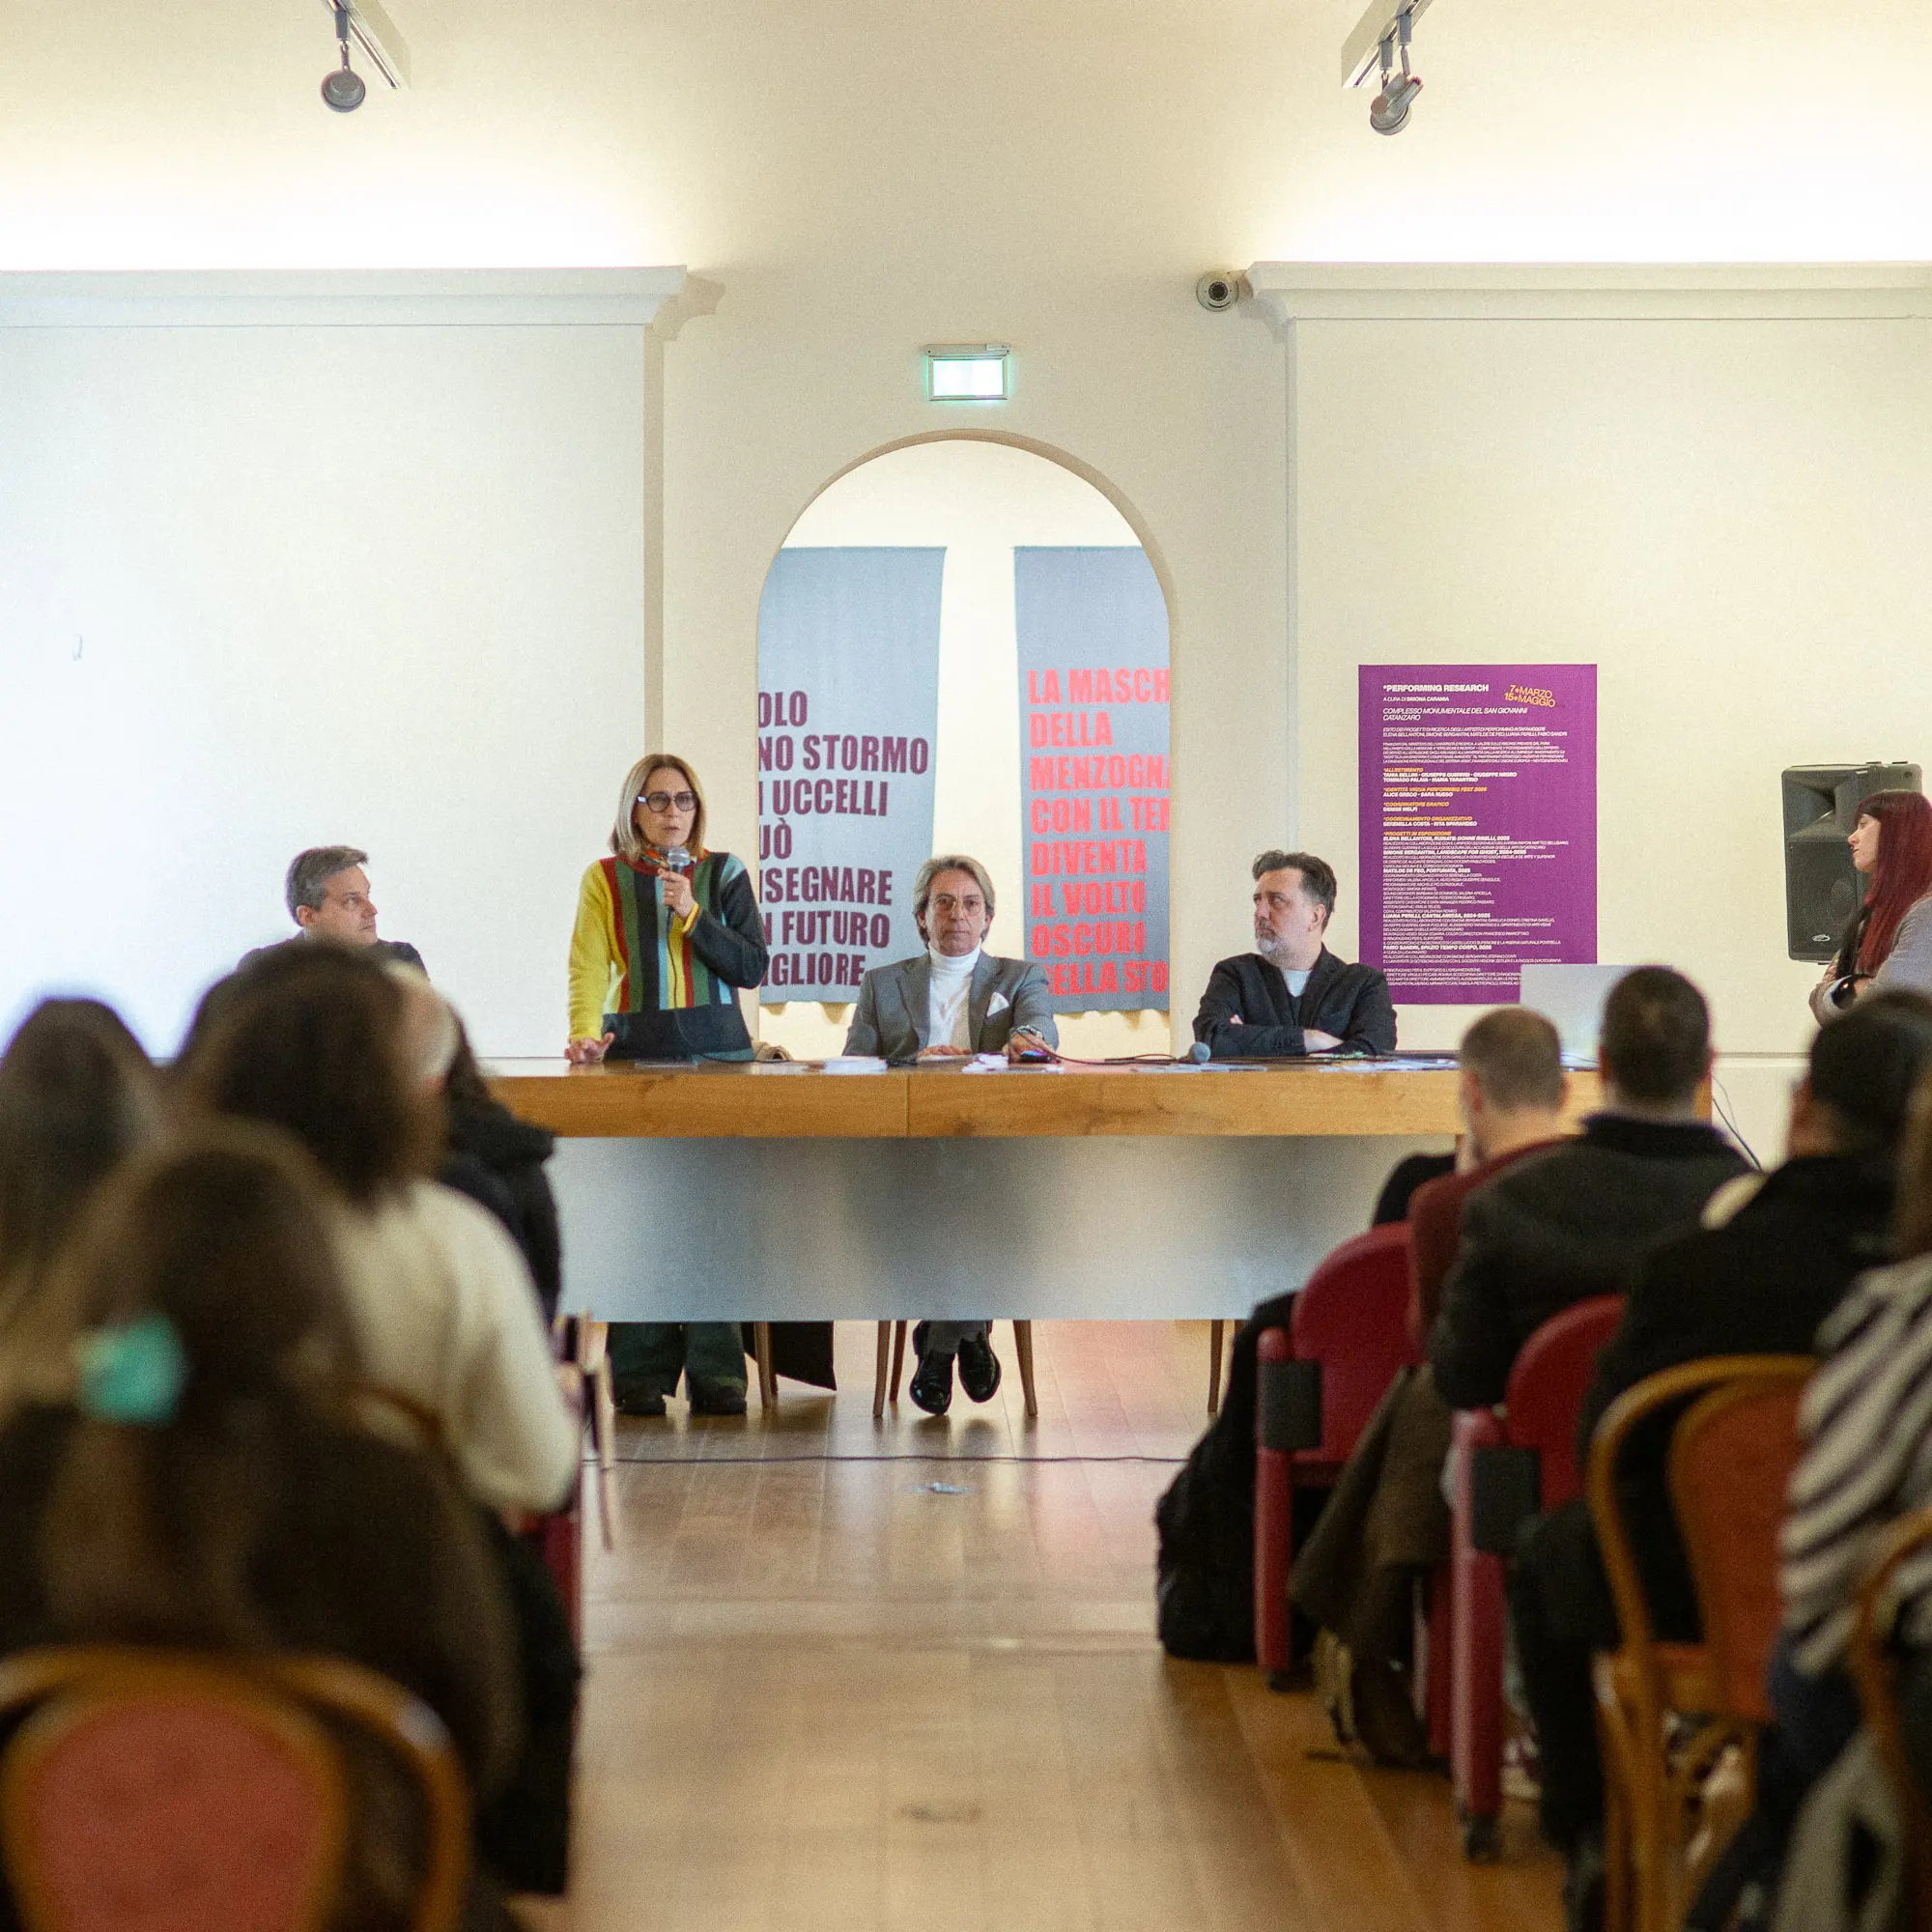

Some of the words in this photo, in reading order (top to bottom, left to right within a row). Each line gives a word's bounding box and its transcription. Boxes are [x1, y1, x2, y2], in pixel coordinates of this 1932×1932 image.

[1028, 668, 1062, 704] LA
[1443, 684, 1489, 693] RESEARCH
[1028, 711, 1113, 748] DELLA
[803, 734, 928, 775] STORMO
[1030, 753, 1170, 791] MENZOGN
[773, 779, 888, 816] UCCELLI
[1031, 797, 1092, 835] CON
[1098, 797, 1124, 832] IL
[1031, 838, 1148, 877] DIVENTA
[1031, 883, 1057, 917] IL
[1062, 880, 1146, 916] VOLTO
[782, 910, 890, 949] FUTURO
[1031, 920, 1146, 957] OSCURO
